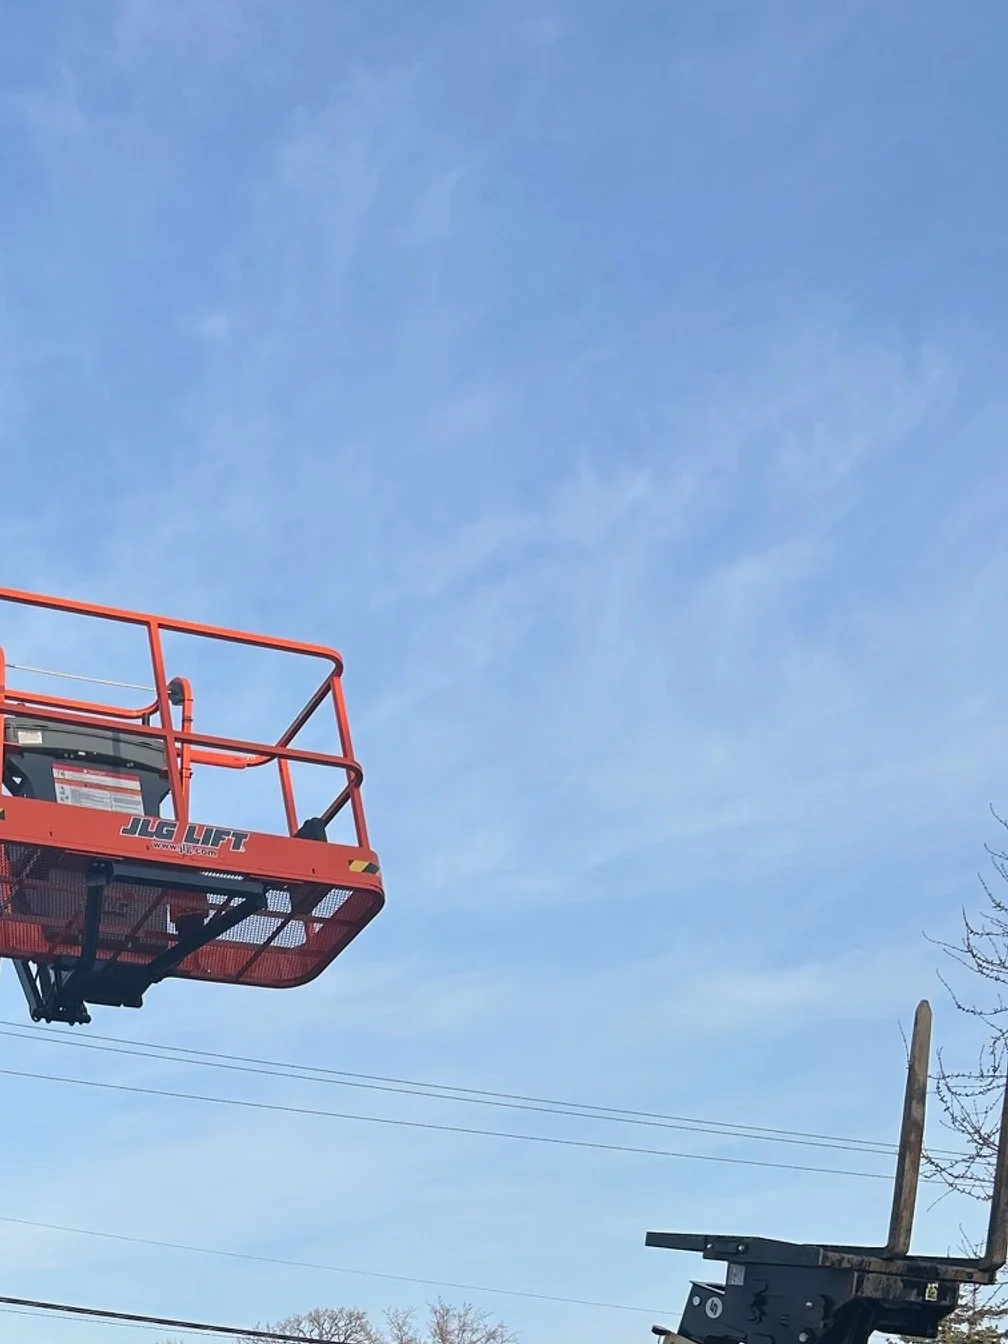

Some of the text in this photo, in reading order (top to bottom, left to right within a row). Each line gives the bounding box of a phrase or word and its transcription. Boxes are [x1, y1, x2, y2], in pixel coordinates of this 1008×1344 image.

[120, 816, 250, 852] JLG LIFT
[152, 841, 218, 857] www.jlg.com
